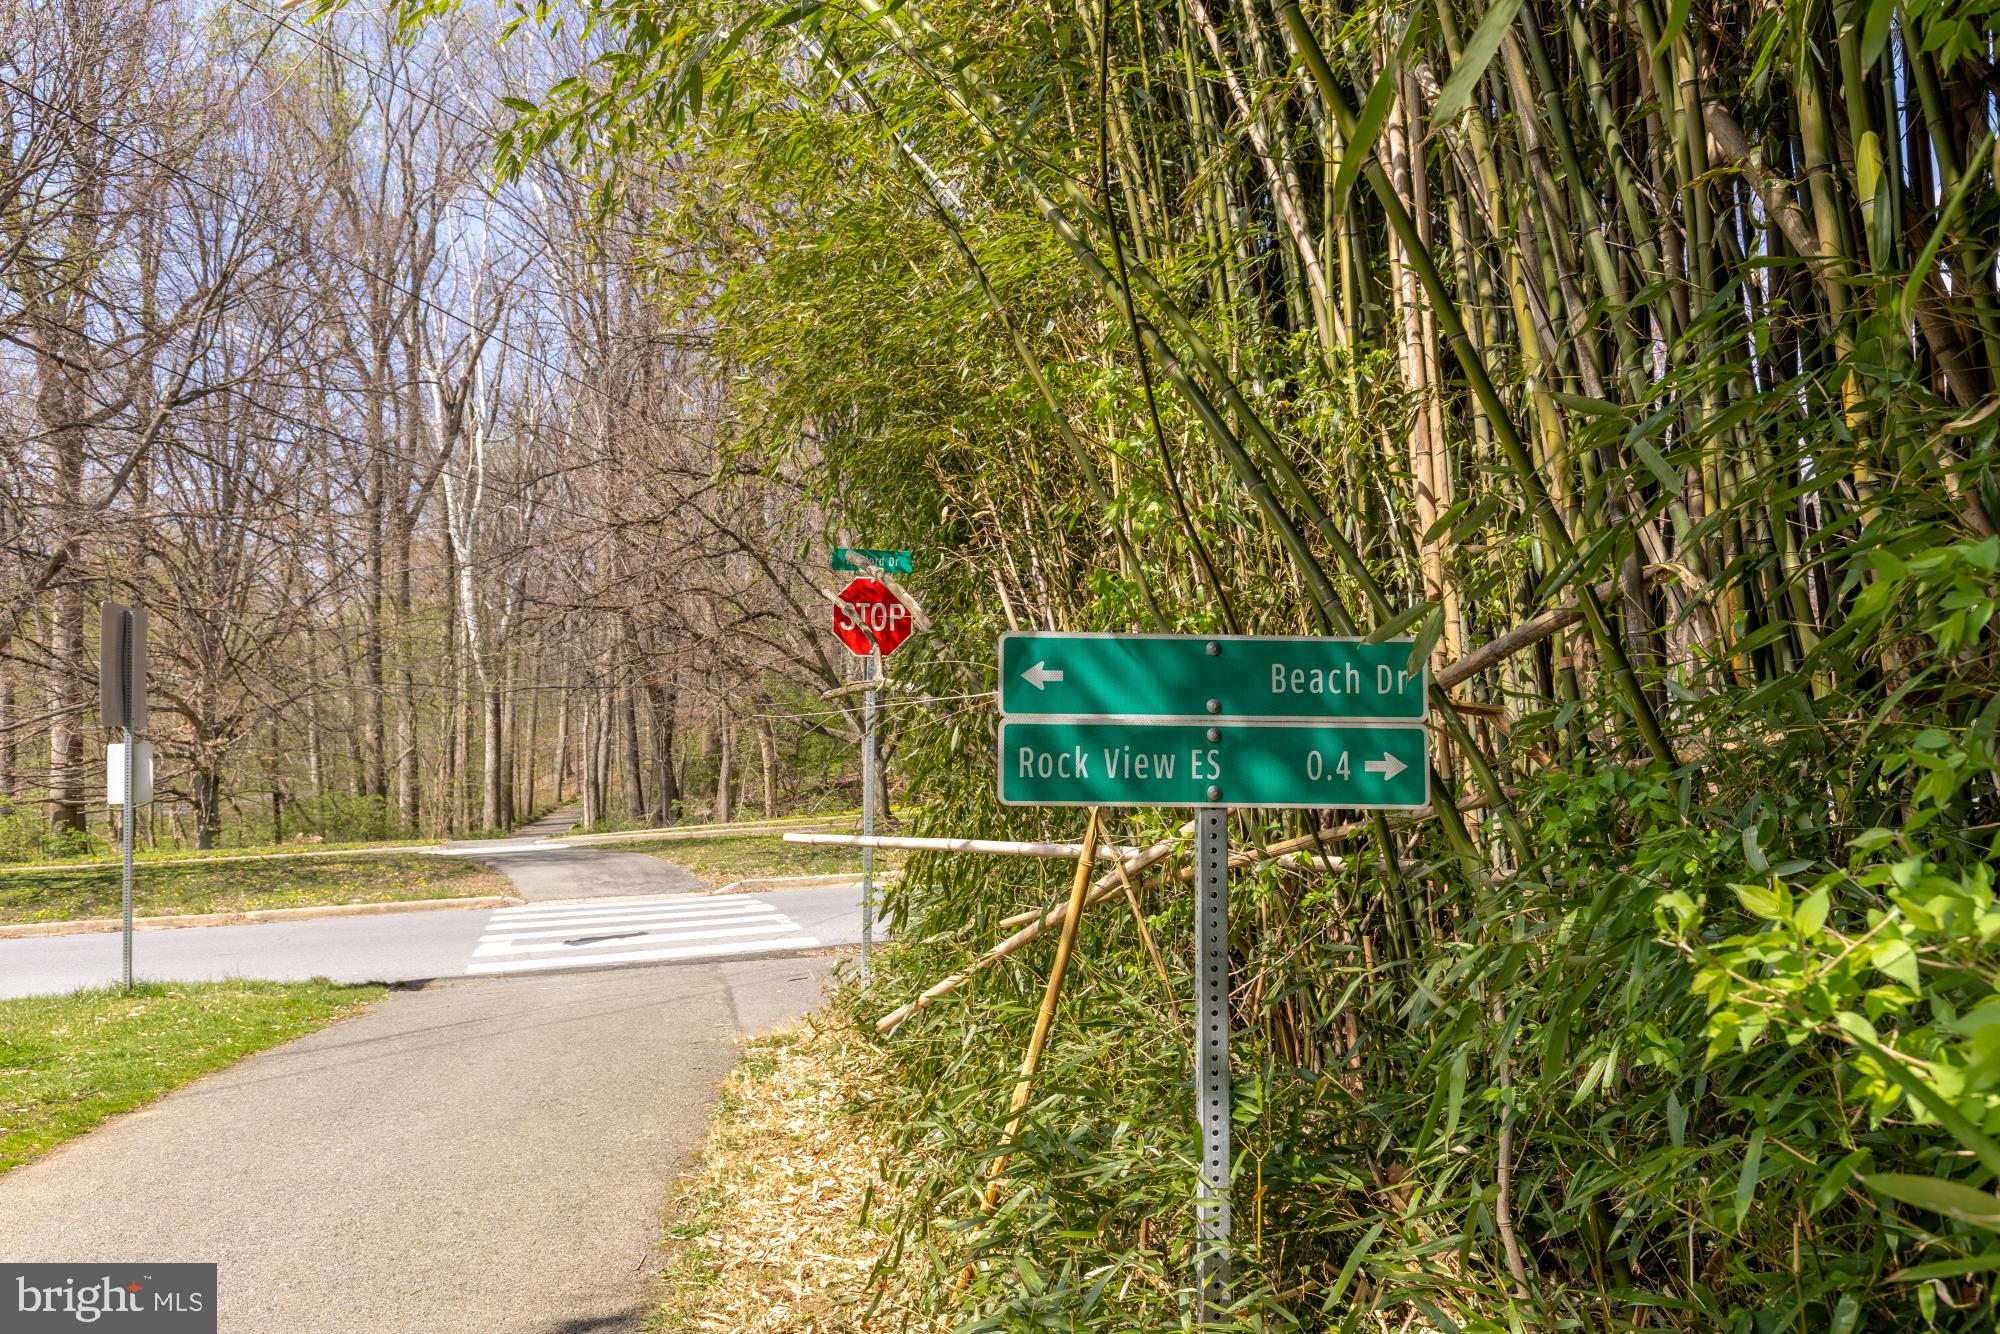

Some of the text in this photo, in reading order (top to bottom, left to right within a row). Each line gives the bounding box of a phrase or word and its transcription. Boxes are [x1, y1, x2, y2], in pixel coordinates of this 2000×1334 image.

[840, 602, 905, 631] STOP
[1271, 662, 1408, 695] Beach Dr
[1019, 745, 1352, 781] Rock View ES 0.4
